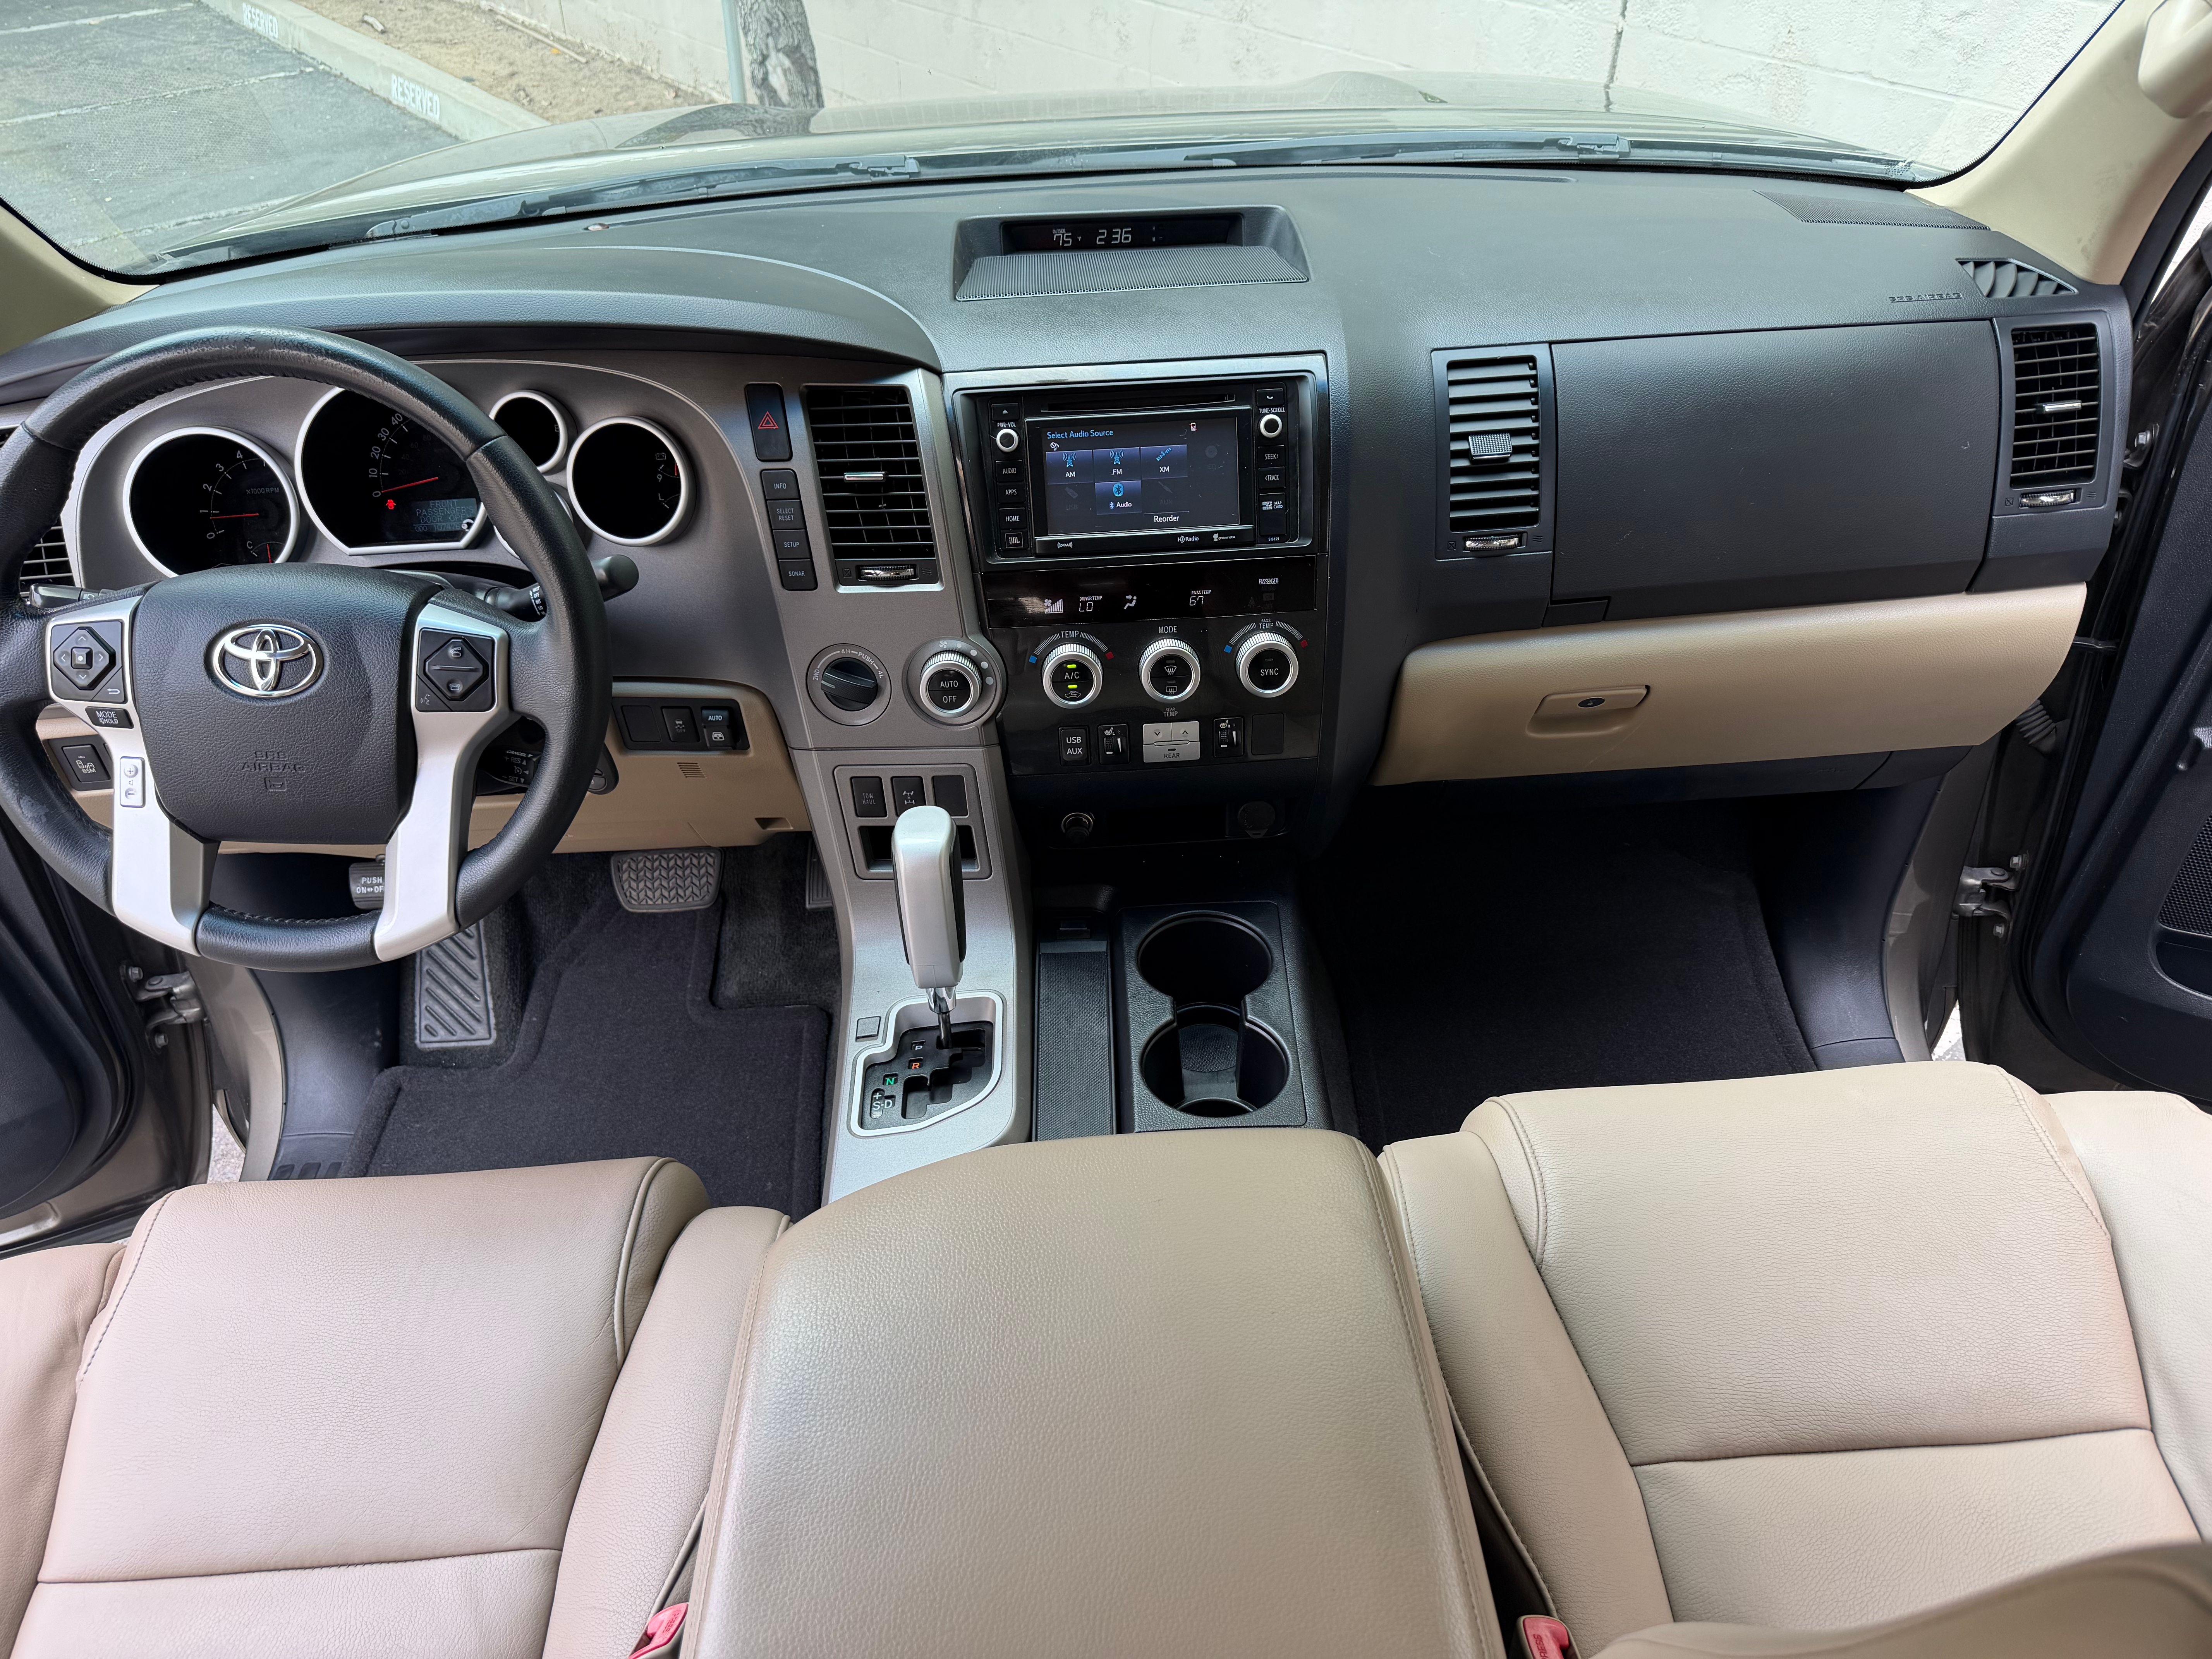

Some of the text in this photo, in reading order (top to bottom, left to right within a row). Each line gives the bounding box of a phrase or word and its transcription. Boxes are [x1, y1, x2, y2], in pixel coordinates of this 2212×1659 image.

[242, 2, 278, 38] RESERVED
[391, 73, 440, 120] RESERVED
[1054, 233, 1072, 246] 75
[392, 413, 403, 425] 40
[378, 428, 390, 441] 30
[1069, 430, 1089, 438] Audio
[237, 450, 243, 459] 4
[370, 446, 381, 460] 20
[215, 463, 224, 472] 3
[369, 468, 378, 478] 10
[1154, 515, 1180, 523] Reorder
[246, 541, 253, 549] C
[1189, 595, 1204, 606] 67
[858, 652, 874, 665] PUSH
[1064, 672, 1079, 680] A/C
[1261, 668, 1279, 676] SYNC
[1533, 1634, 1549, 1659] RESS
